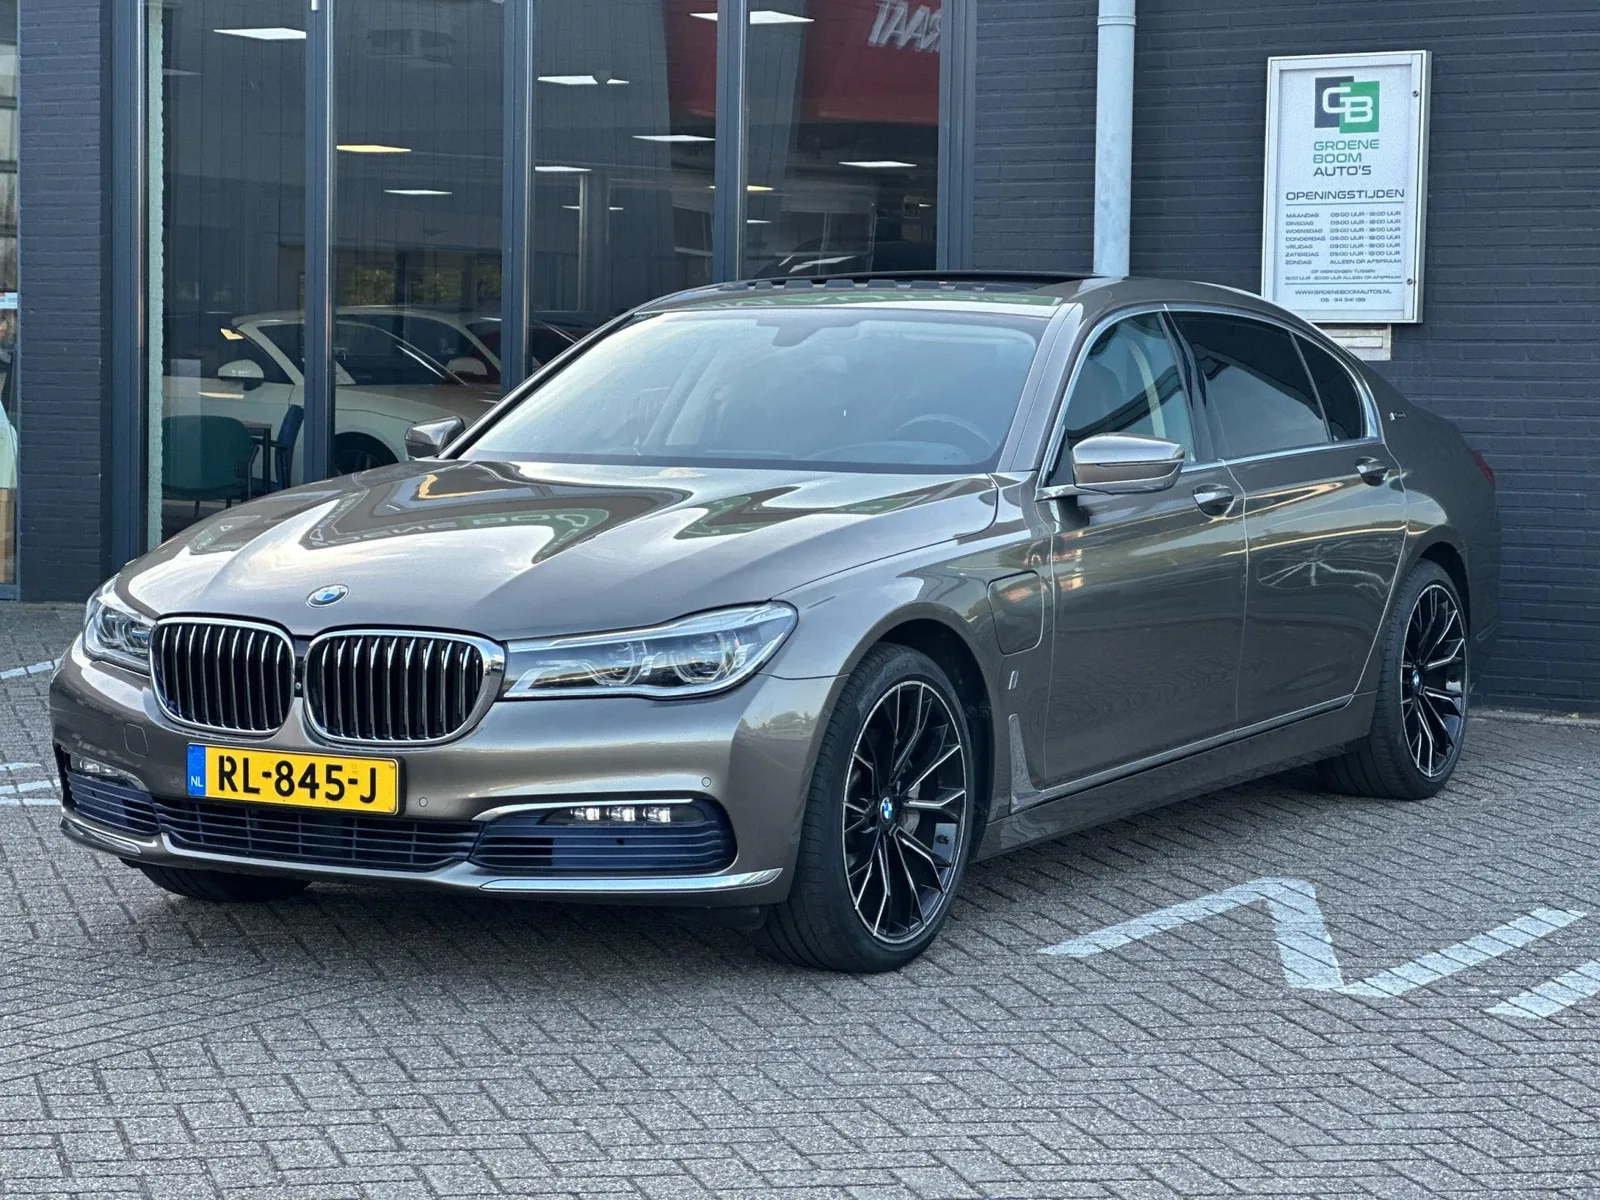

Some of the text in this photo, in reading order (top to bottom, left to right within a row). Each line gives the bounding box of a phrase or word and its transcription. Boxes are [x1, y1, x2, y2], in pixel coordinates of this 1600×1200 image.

[1313, 139, 1379, 151] GROENE
[1313, 153, 1362, 164] BOOM
[1313, 165, 1372, 177] AUTO'S
[1285, 188, 1405, 201] OPENINGSTIJDEN
[190, 755, 377, 804] NL RL-845-J
